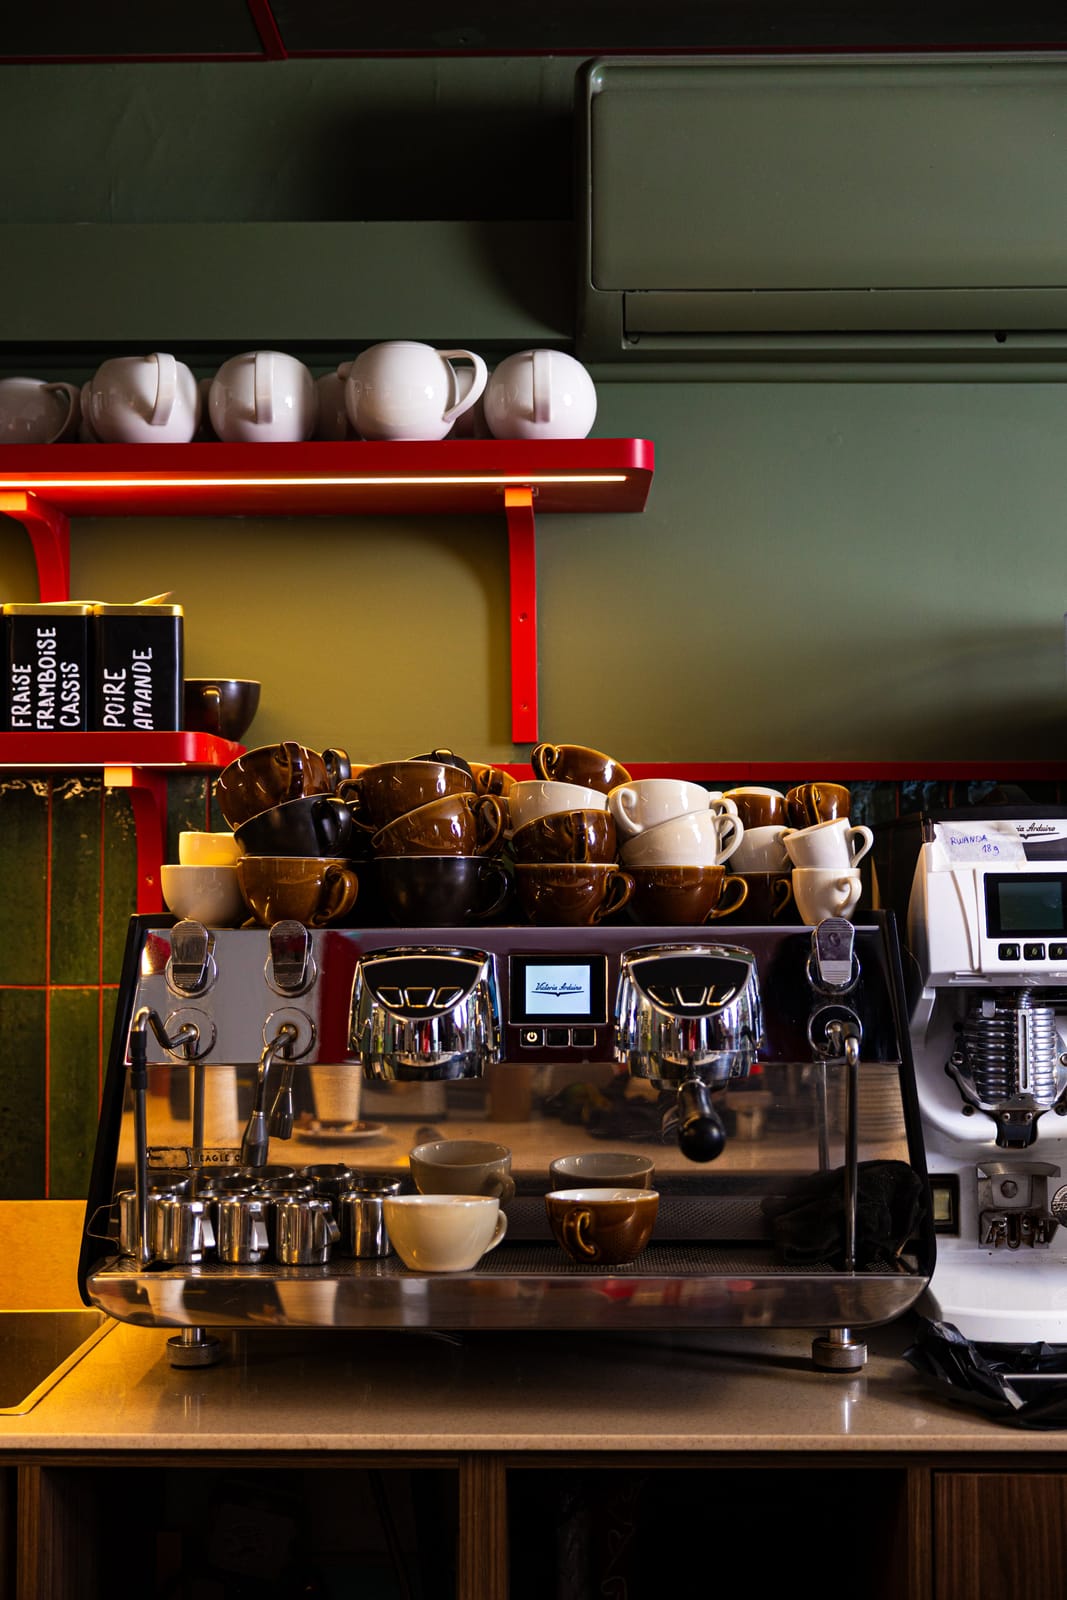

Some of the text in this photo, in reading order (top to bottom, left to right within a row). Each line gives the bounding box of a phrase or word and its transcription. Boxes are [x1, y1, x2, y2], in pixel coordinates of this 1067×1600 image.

[132, 647, 154, 730] AMANDE
[951, 834, 988, 845] RWANDA
[536, 982, 582, 990] Victoria Arduino
